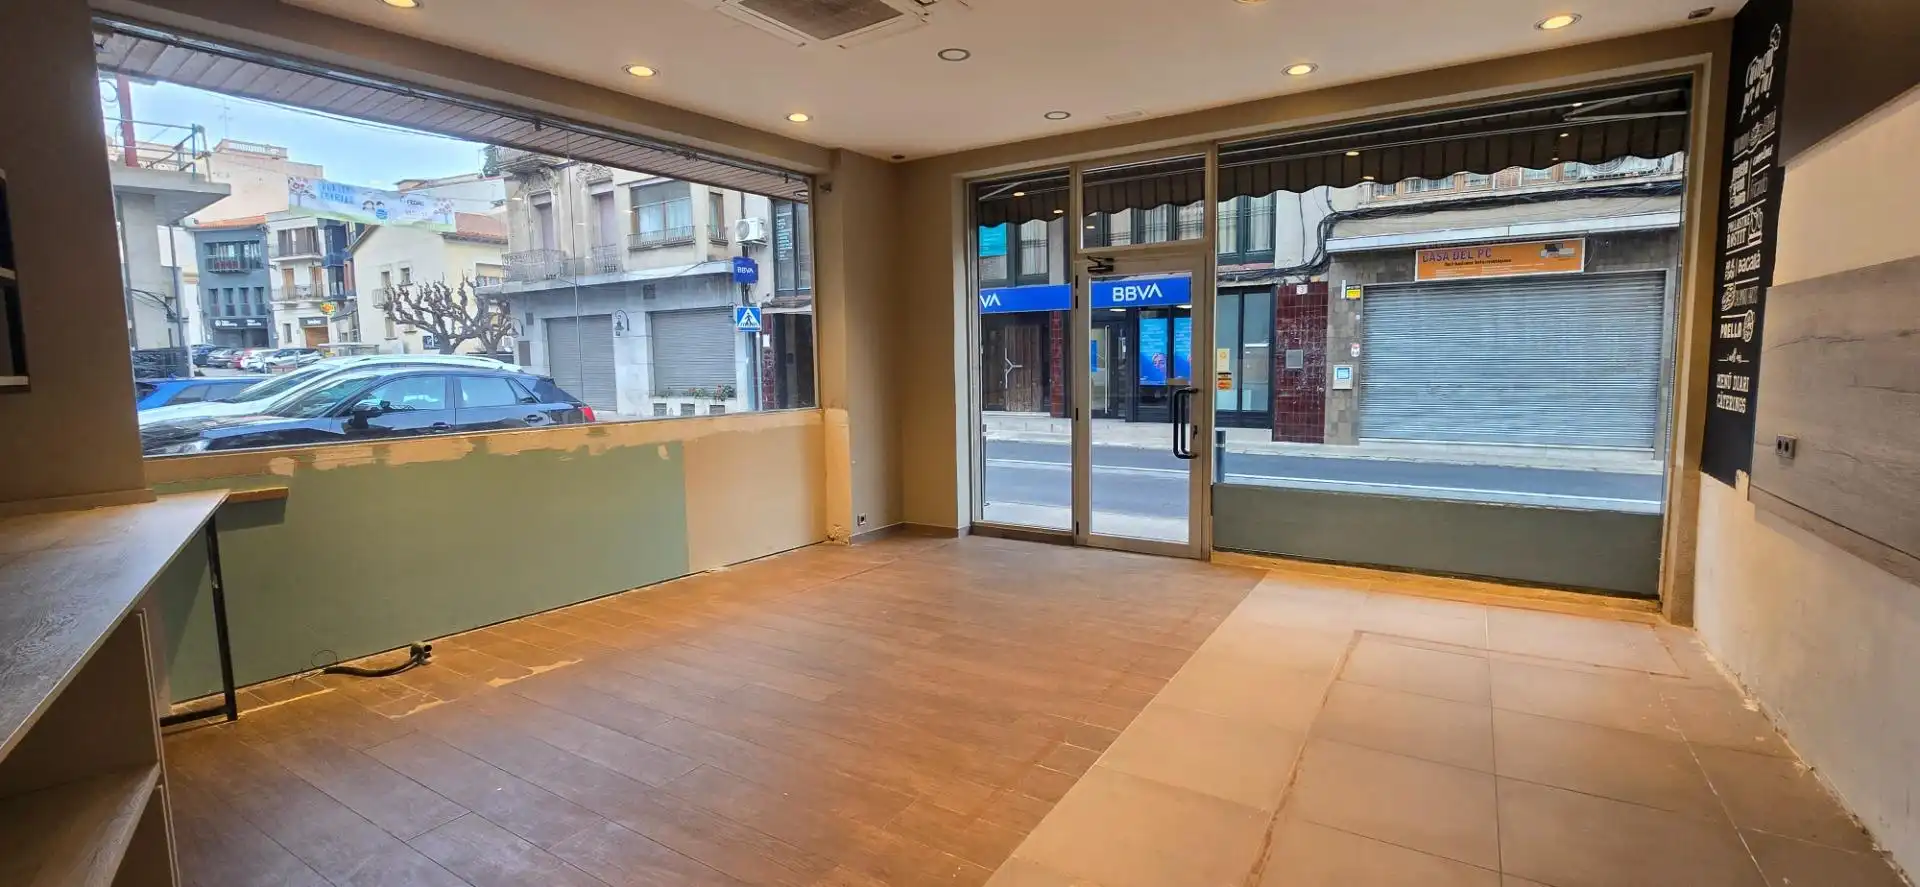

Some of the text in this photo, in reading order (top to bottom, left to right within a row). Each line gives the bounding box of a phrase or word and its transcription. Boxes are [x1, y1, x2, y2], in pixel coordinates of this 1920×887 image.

[1452, 249, 1474, 260] DEL
[1477, 247, 1492, 258] PC
[736, 266, 754, 274] BBVA
[1112, 282, 1163, 303] BBVA
[980, 293, 1001, 308] VA
[1719, 322, 1742, 339] PAELLA
